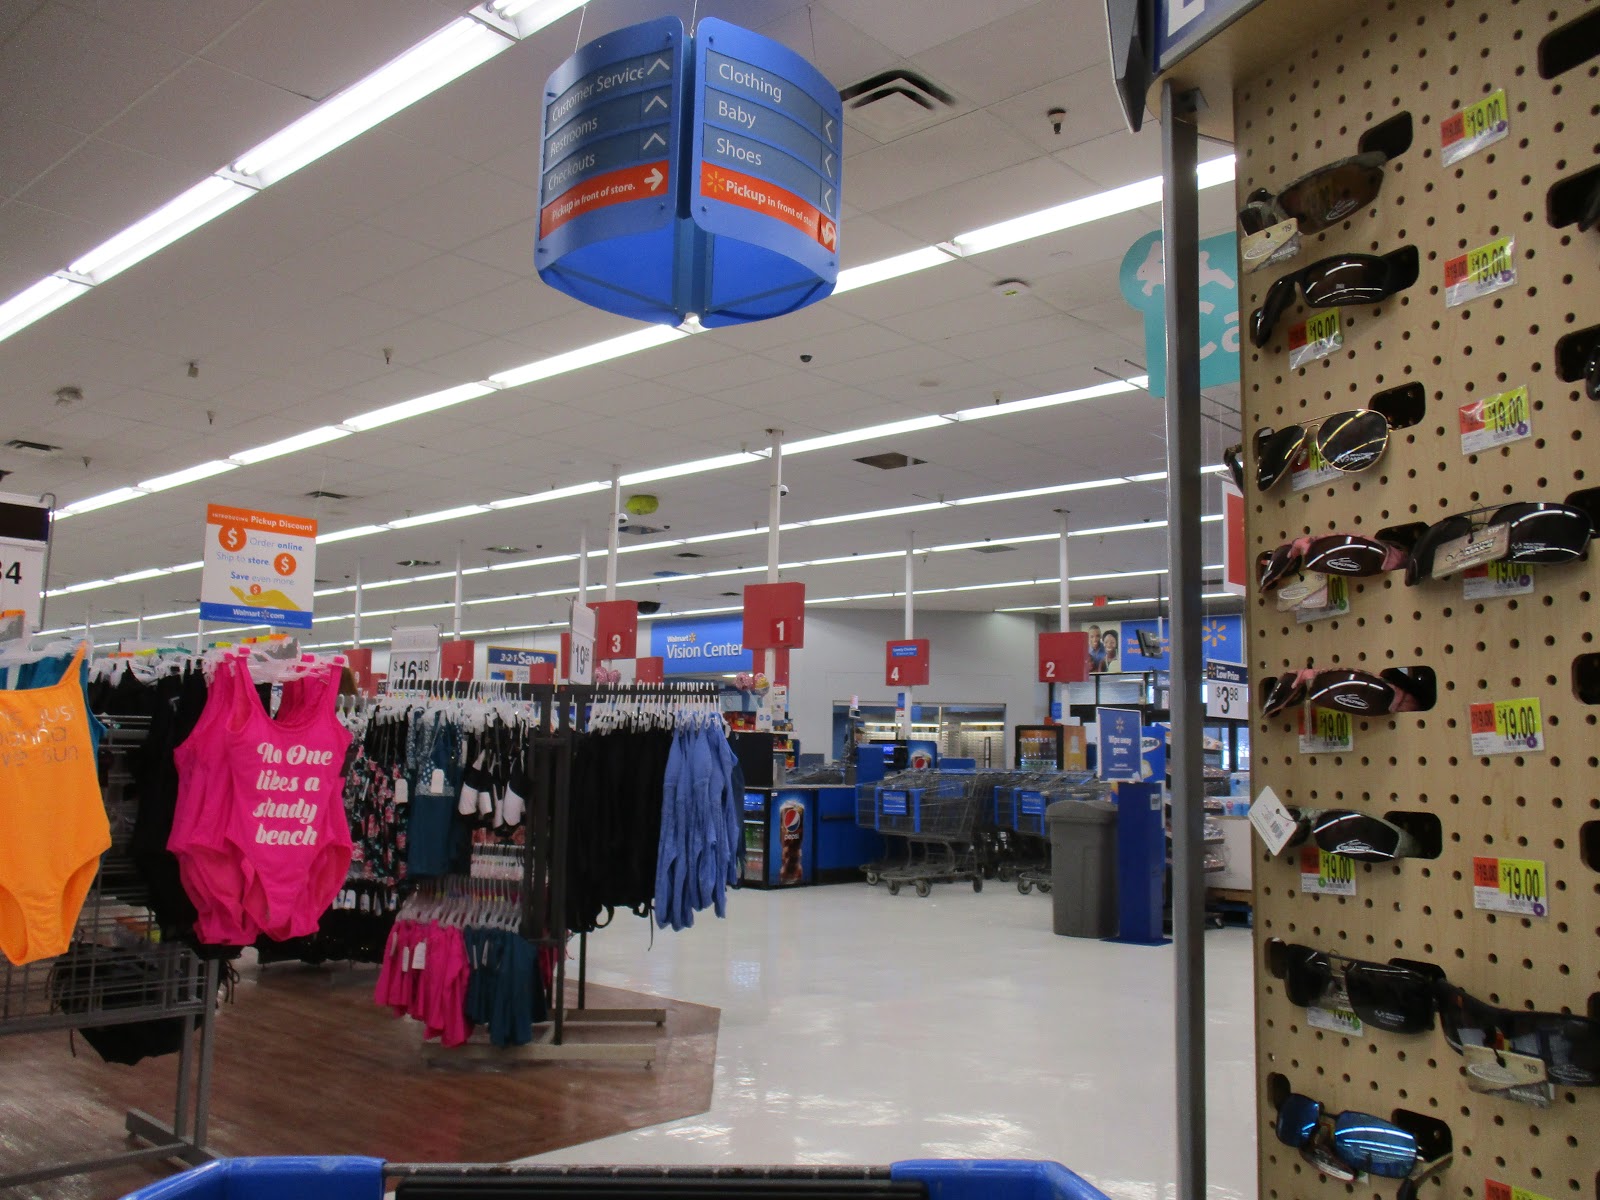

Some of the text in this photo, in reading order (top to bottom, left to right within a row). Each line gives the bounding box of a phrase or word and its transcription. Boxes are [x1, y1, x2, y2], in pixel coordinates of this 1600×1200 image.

[553, 67, 645, 122] Customer Service
[719, 64, 782, 103] Clothing
[718, 100, 757, 129] Baby
[550, 117, 598, 158] Restrooms
[716, 138, 762, 166] Shoes
[548, 152, 595, 191] Checkouts
[552, 182, 636, 222] Pickup in front of store.
[726, 180, 766, 204] Pickup
[767, 196, 776, 207] in
[777, 200, 796, 217] front
[796, 205, 804, 220] of
[250, 516, 277, 527] Pickup
[279, 520, 313, 532] Discount
[249, 538, 275, 548] Order
[216, 552, 234, 563] Ship
[230, 572, 250, 581] Save
[666, 635, 689, 643] Walmart
[776, 621, 785, 640] 1
[612, 634, 621, 653] 3
[667, 642, 743, 659] Vision Center
[517, 652, 546, 665] Save
[1046, 661, 1056, 678] 2
[457, 665, 463, 679] 7
[891, 667, 899, 681] 4
[1216, 669, 1240, 681] Low Price
[1498, 706, 1535, 741] $19.00
[257, 742, 333, 765] No One
[256, 770, 321, 792] likes a
[252, 797, 318, 825] shady
[255, 823, 318, 846] beach
[1322, 855, 1351, 884] $19.00
[1503, 867, 1540, 903] $19.00
